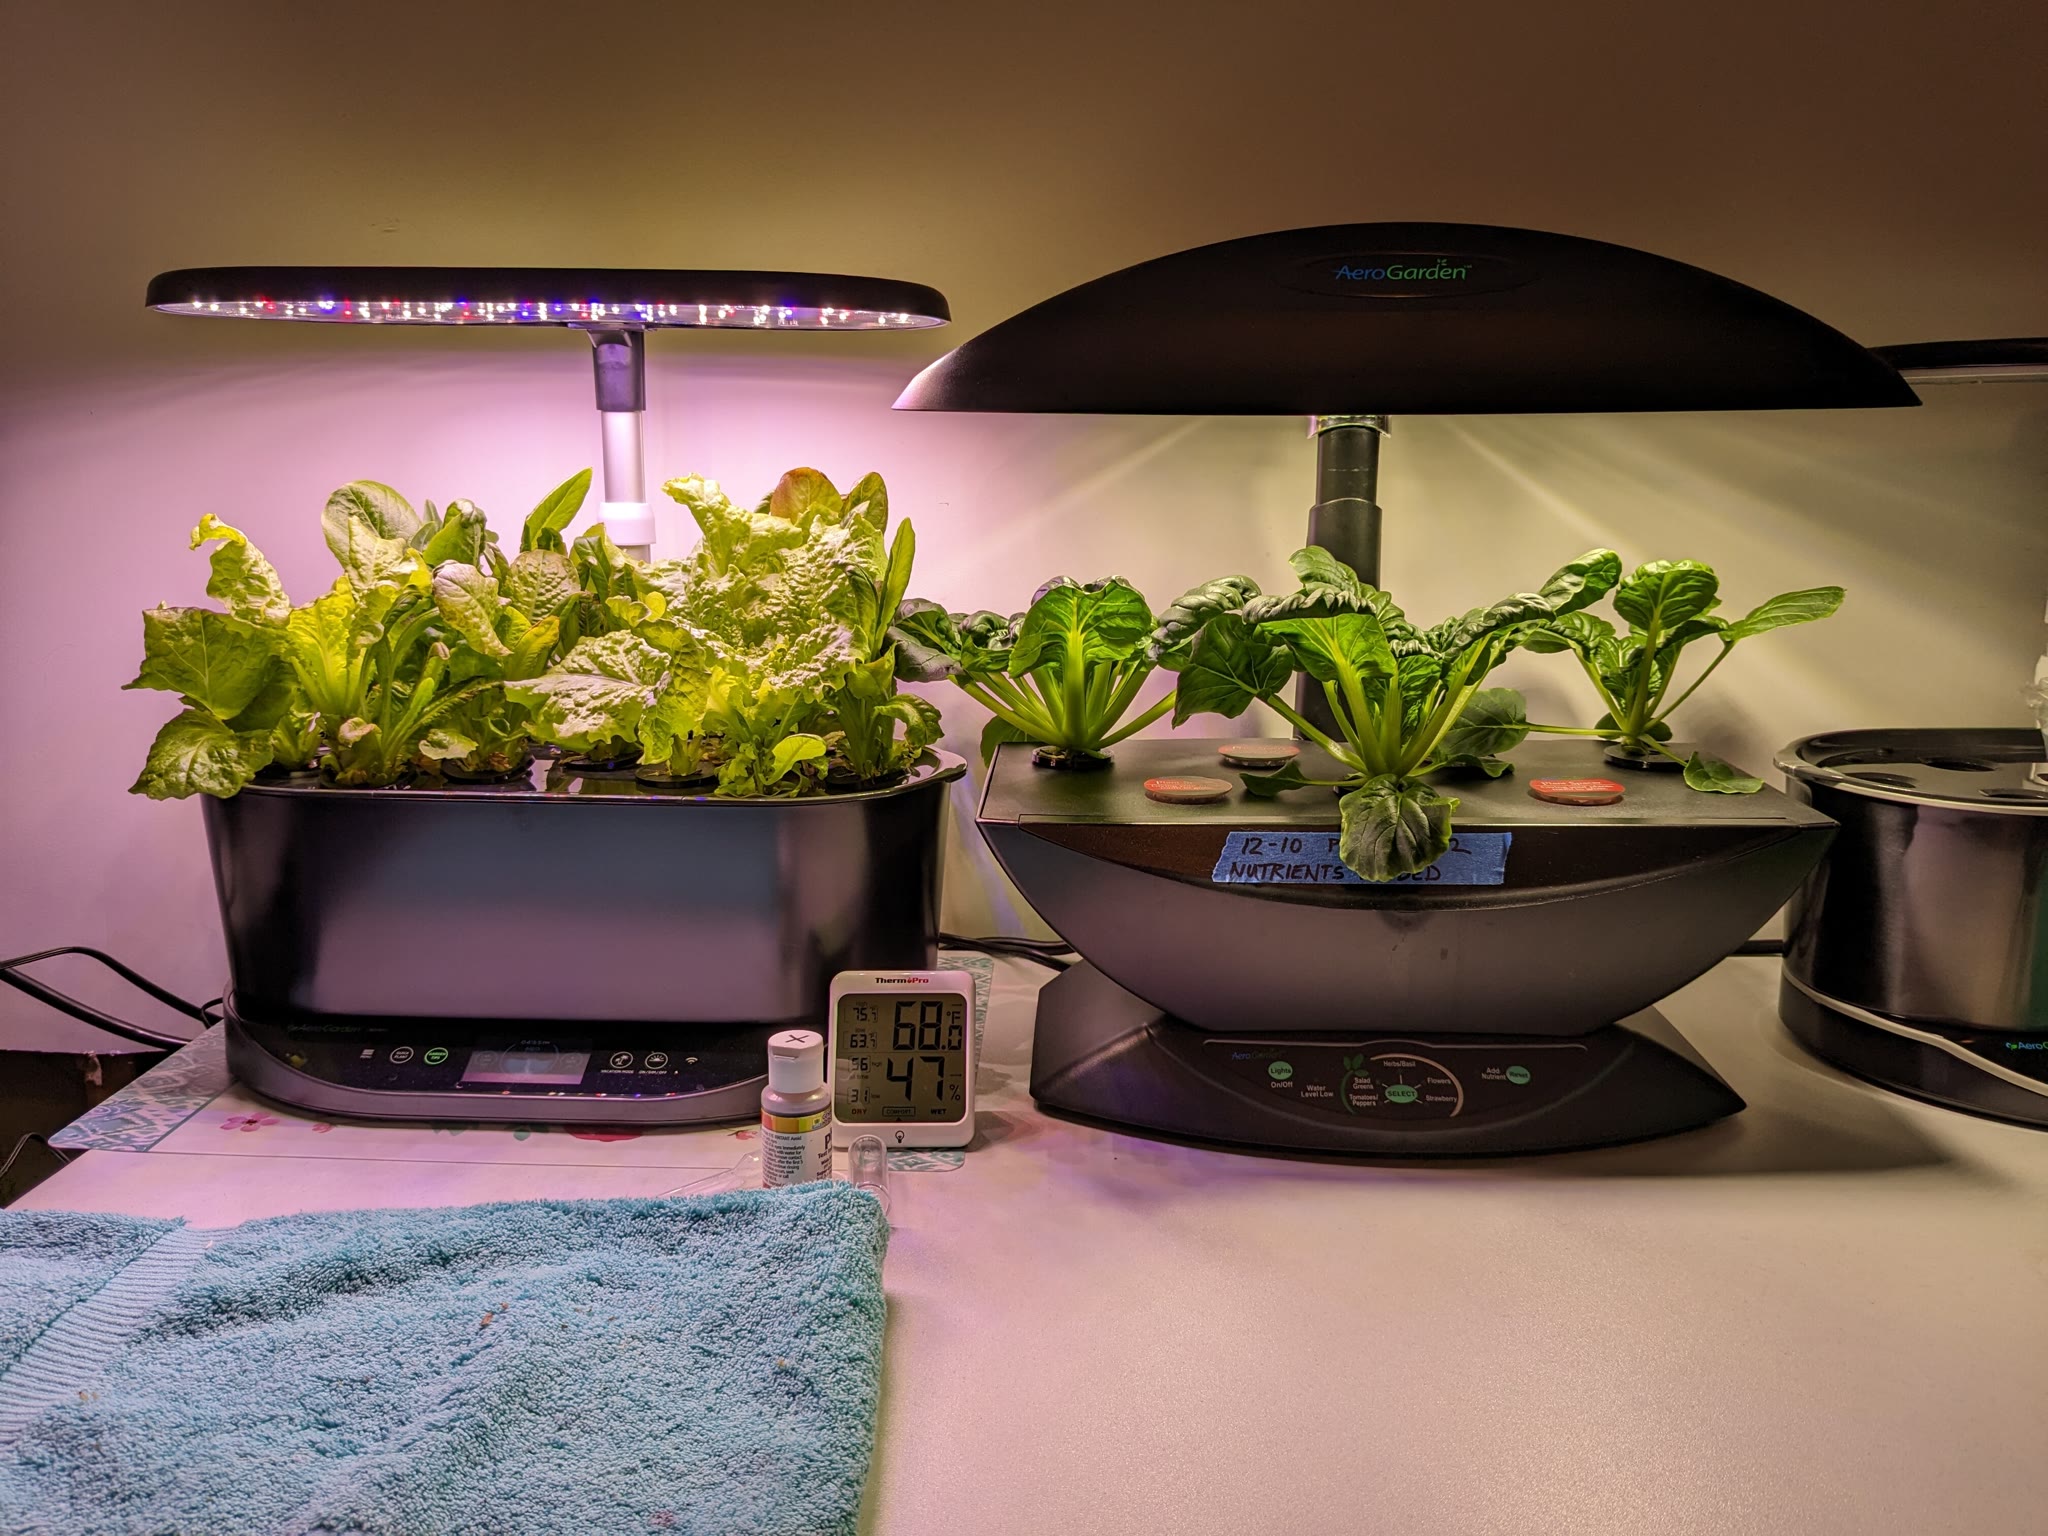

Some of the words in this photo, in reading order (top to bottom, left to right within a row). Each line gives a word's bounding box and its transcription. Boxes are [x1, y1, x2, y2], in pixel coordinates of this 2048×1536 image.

[1333, 262, 1467, 281] AeroGarden
[1241, 837, 1303, 855] 12-10
[1229, 861, 1345, 882] NUTRIENTS
[886, 1056, 946, 1101] 47
[1270, 1067, 1292, 1076] Lights
[1352, 1099, 1377, 1107] Peppers
[1425, 1094, 1458, 1103] Strawberry
